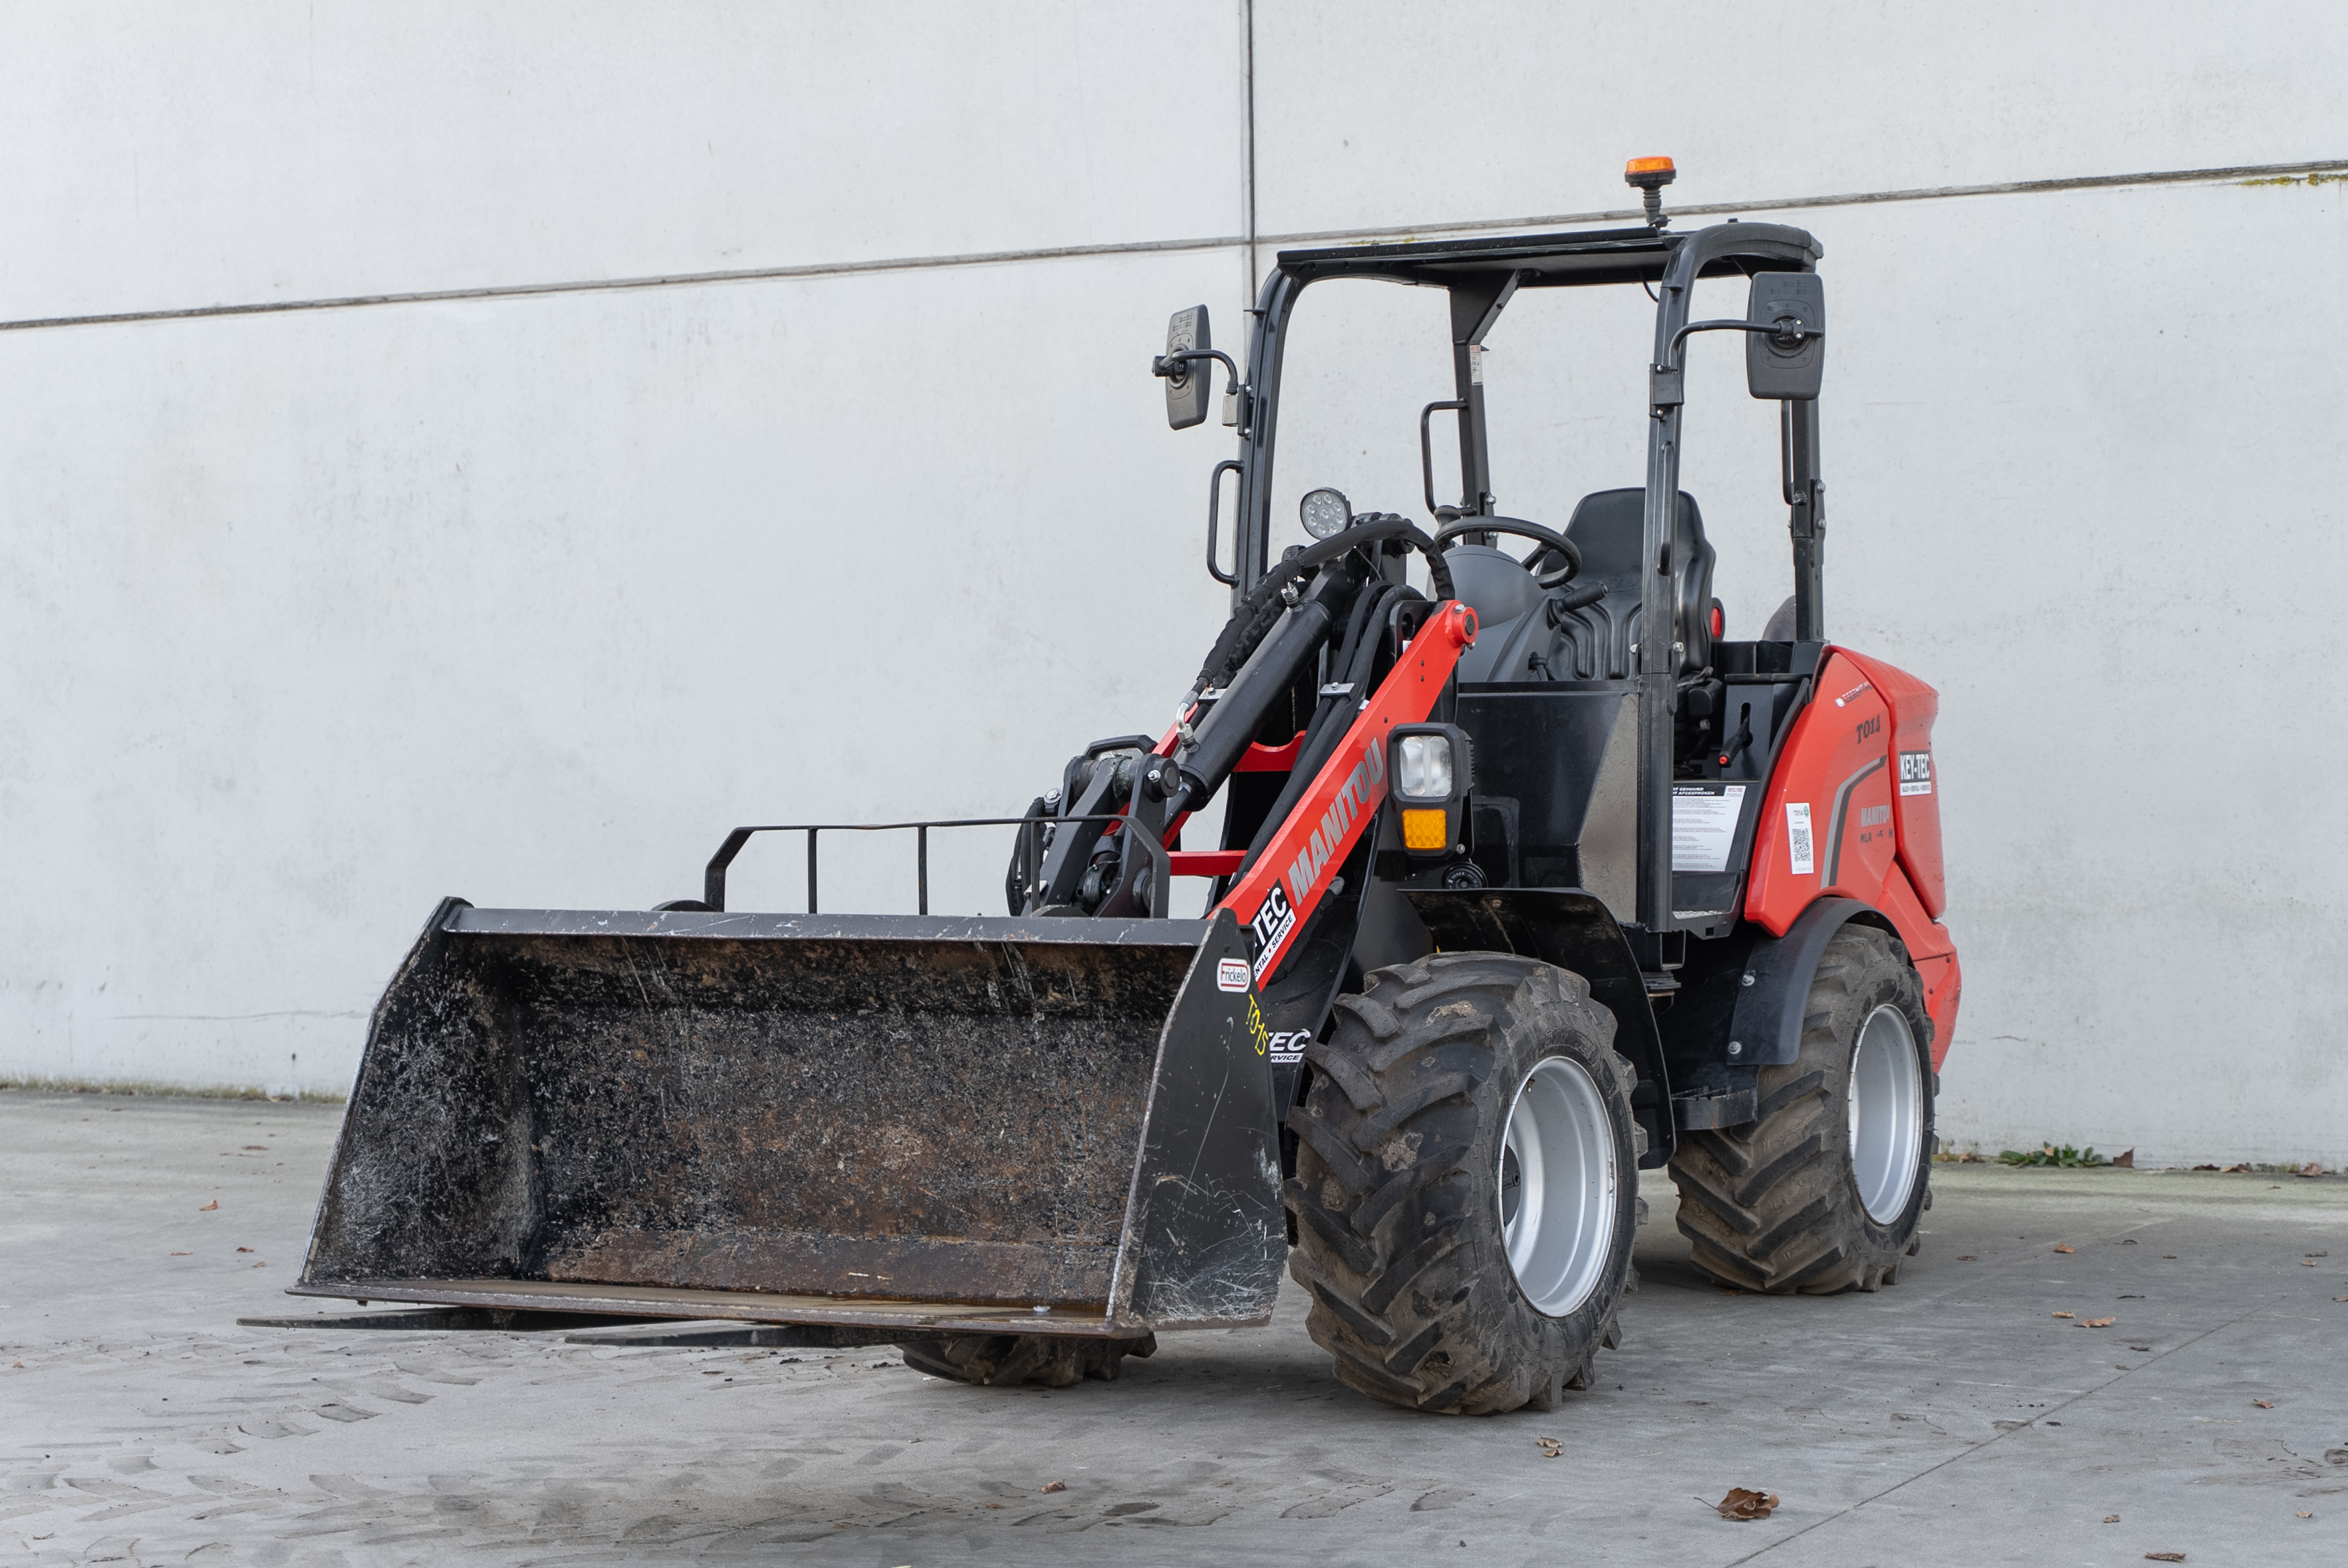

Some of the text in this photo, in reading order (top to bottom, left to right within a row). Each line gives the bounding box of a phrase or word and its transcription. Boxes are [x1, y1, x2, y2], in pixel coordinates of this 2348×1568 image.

[1900, 753, 1930, 780] KEY-TEC
[1288, 737, 1383, 907] MANITOU
[1252, 887, 1287, 948] TEC
[1271, 914, 1293, 948] SERVICE
[1221, 963, 1247, 983] Frickelo
[1268, 1028, 1311, 1051] EC
